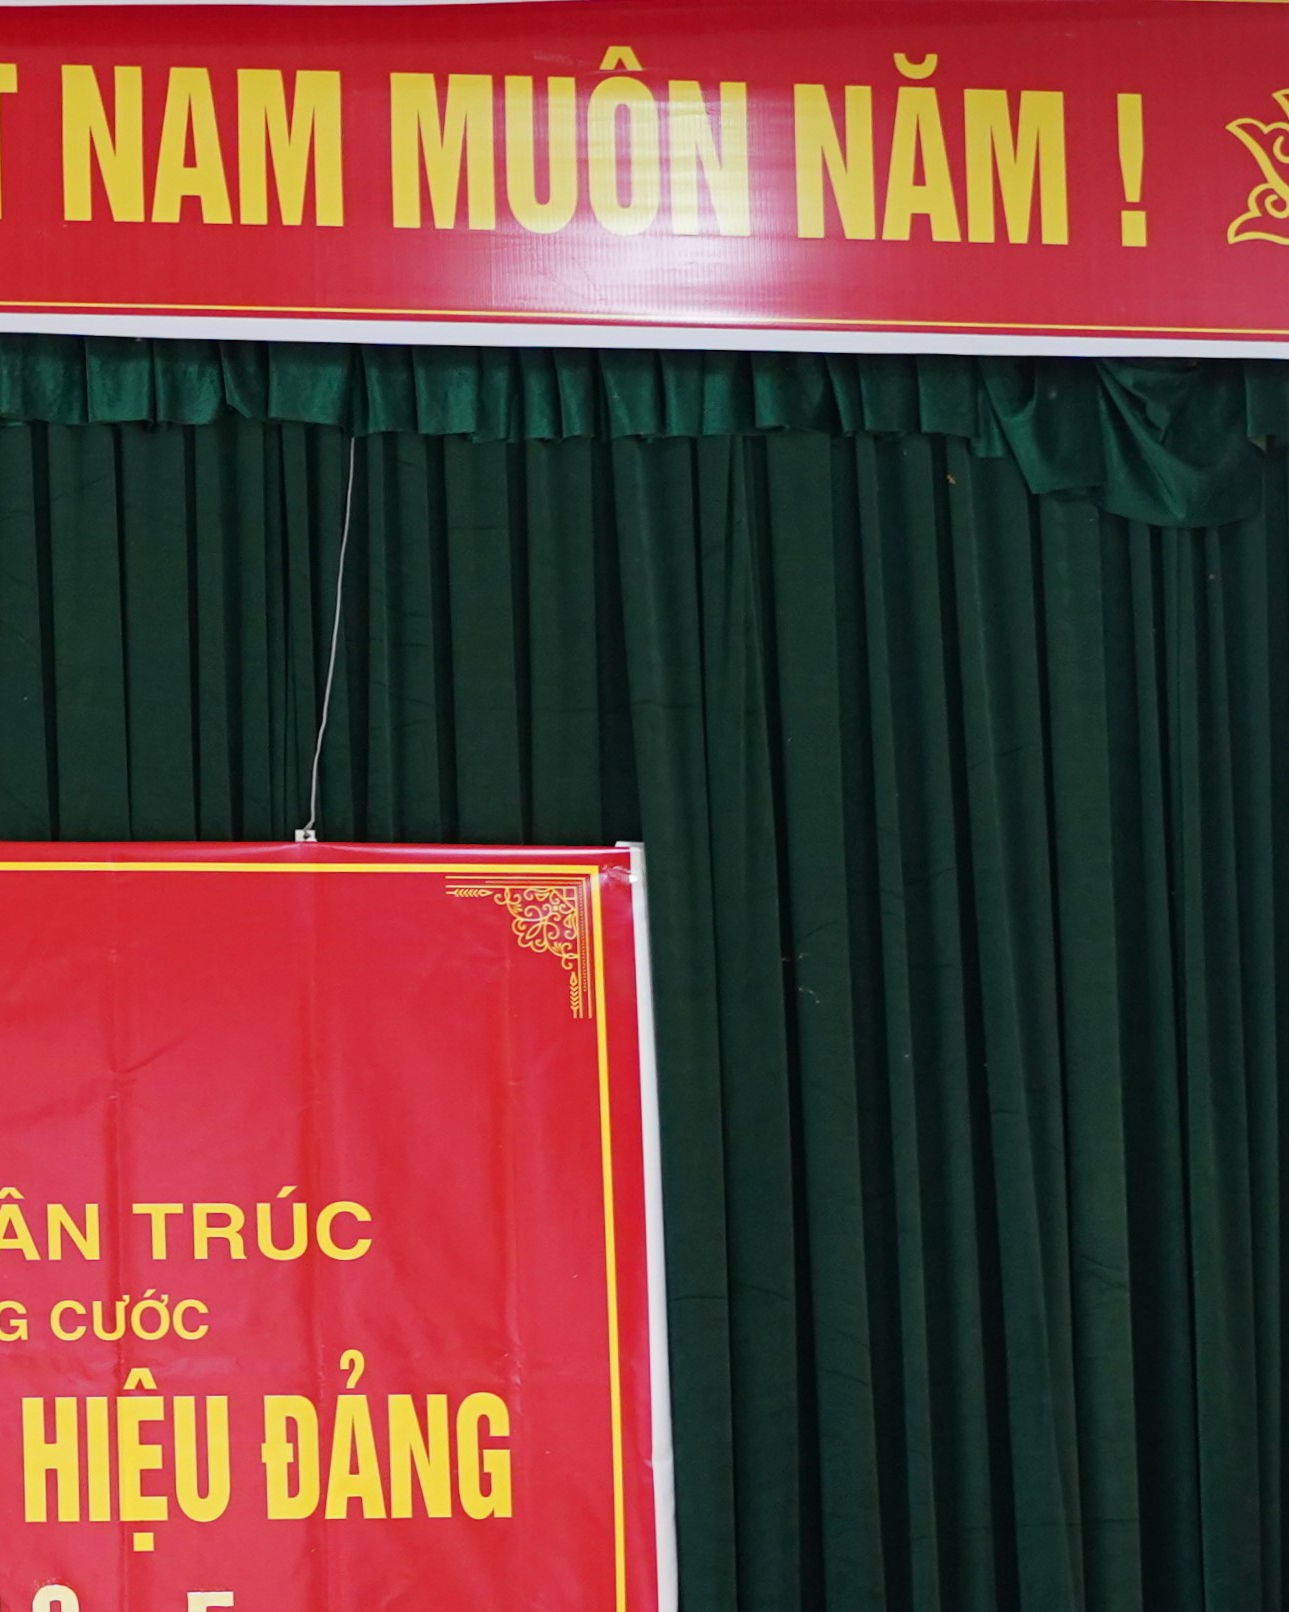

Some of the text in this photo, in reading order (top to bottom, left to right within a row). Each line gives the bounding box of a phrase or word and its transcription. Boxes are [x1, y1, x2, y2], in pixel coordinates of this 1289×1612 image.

[61, 65, 344, 227] NAM
[390, 46, 751, 238] MUÔN
[794, 53, 1069, 245] NĂM
[1117, 93, 1148, 247] !
[132, 1186, 373, 1261] TRÚC
[49, 1289, 209, 1341] CƯỚC
[21, 1367, 231, 1552] HIỆU
[261, 1349, 513, 1520] ĐẢNG
